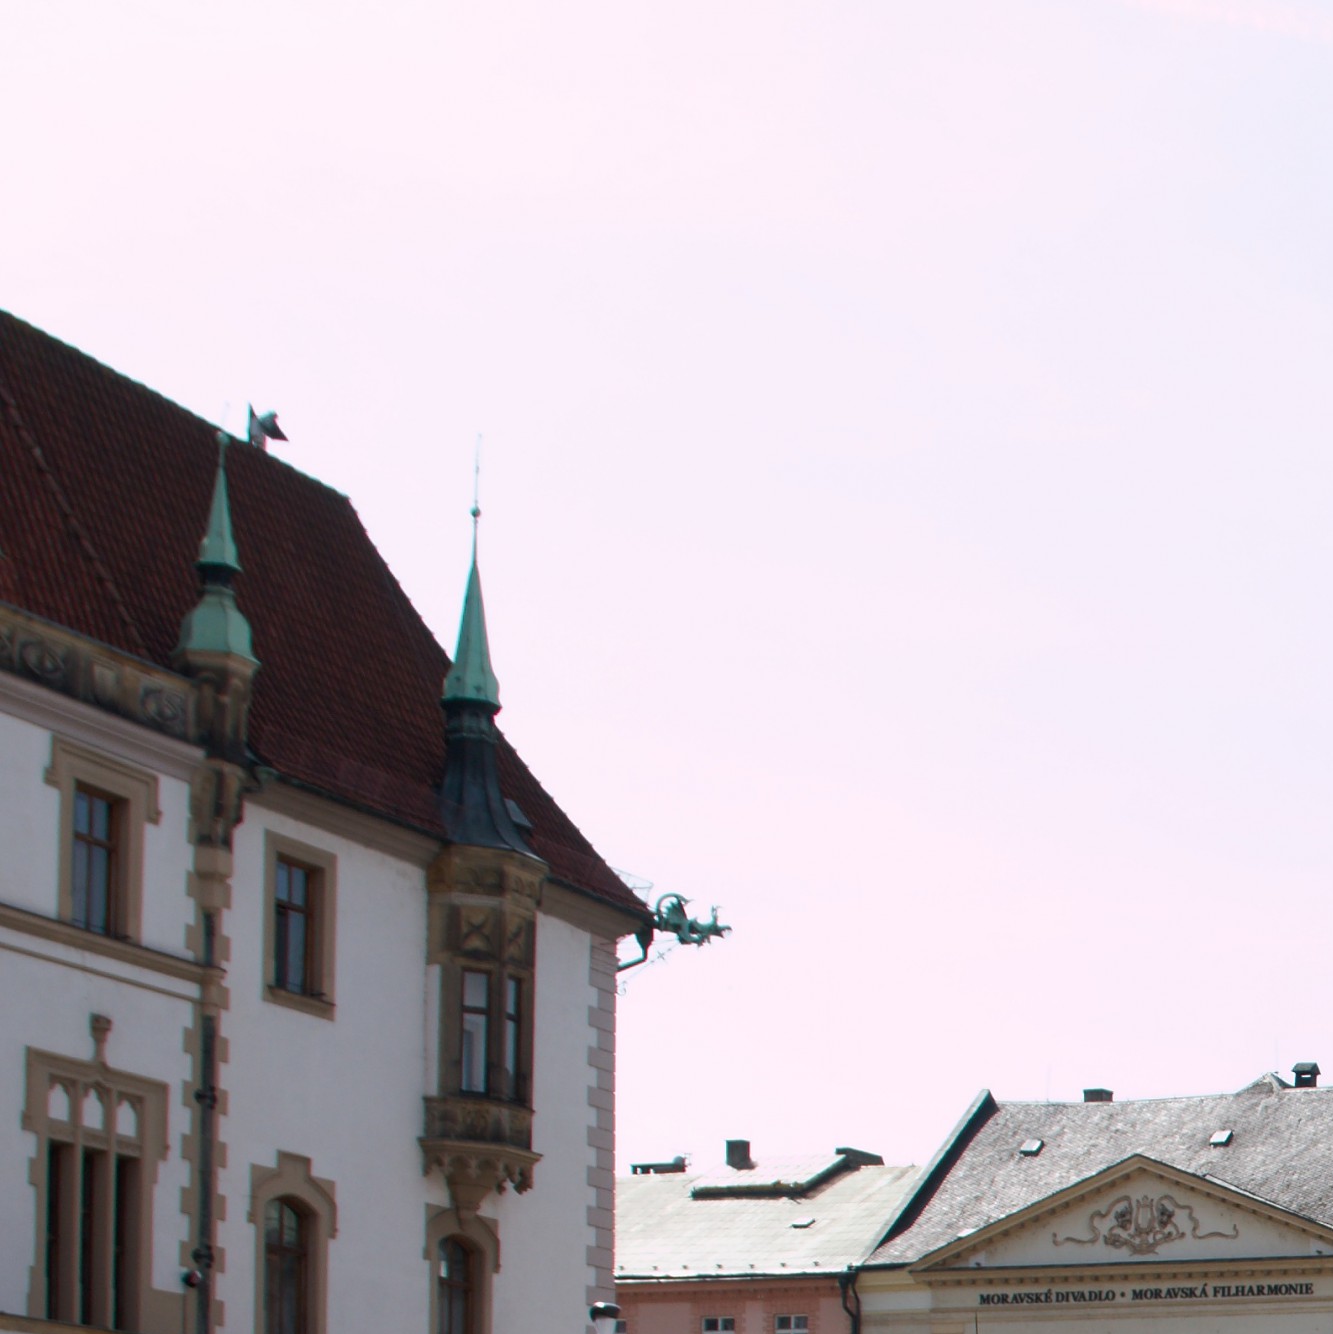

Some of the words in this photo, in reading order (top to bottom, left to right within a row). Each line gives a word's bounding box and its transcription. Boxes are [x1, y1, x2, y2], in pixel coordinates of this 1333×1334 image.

[979, 1289, 1053, 1305] MORAVSKÉ
[1055, 1289, 1116, 1303] DIVADLO
[1131, 1283, 1209, 1300] MORAVSKÁ
[1213, 1283, 1314, 1298] FILHARMONIE
